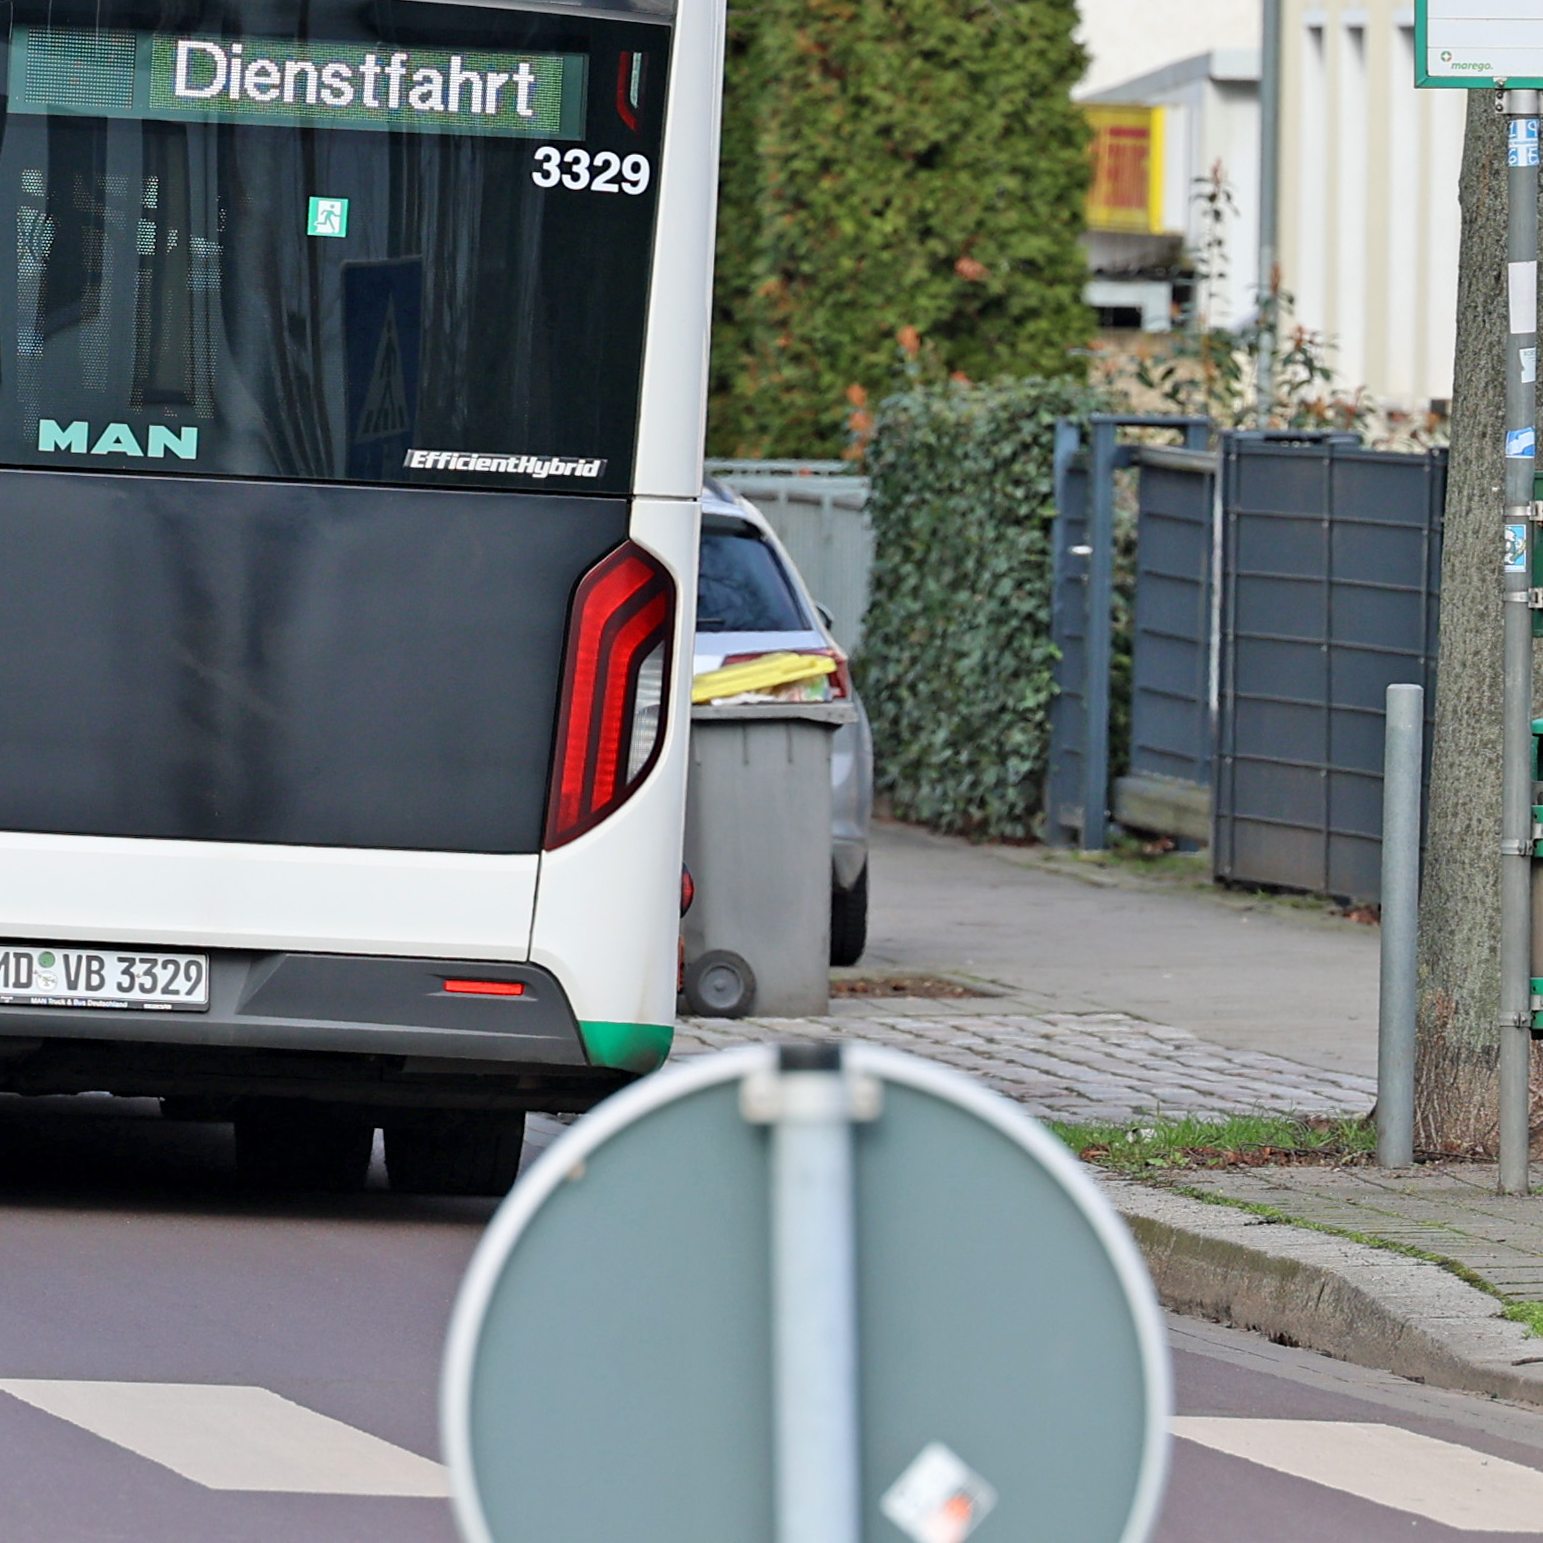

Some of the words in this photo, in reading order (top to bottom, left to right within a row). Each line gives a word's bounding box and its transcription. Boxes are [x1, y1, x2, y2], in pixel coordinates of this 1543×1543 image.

[174, 40, 535, 118] Dienstfahrt
[532, 146, 650, 195] 3329
[38, 419, 197, 459] MAN
[410, 450, 601, 479] EfficientHybrid
[63, 954, 105, 991] VB
[117, 957, 203, 996] 3329
